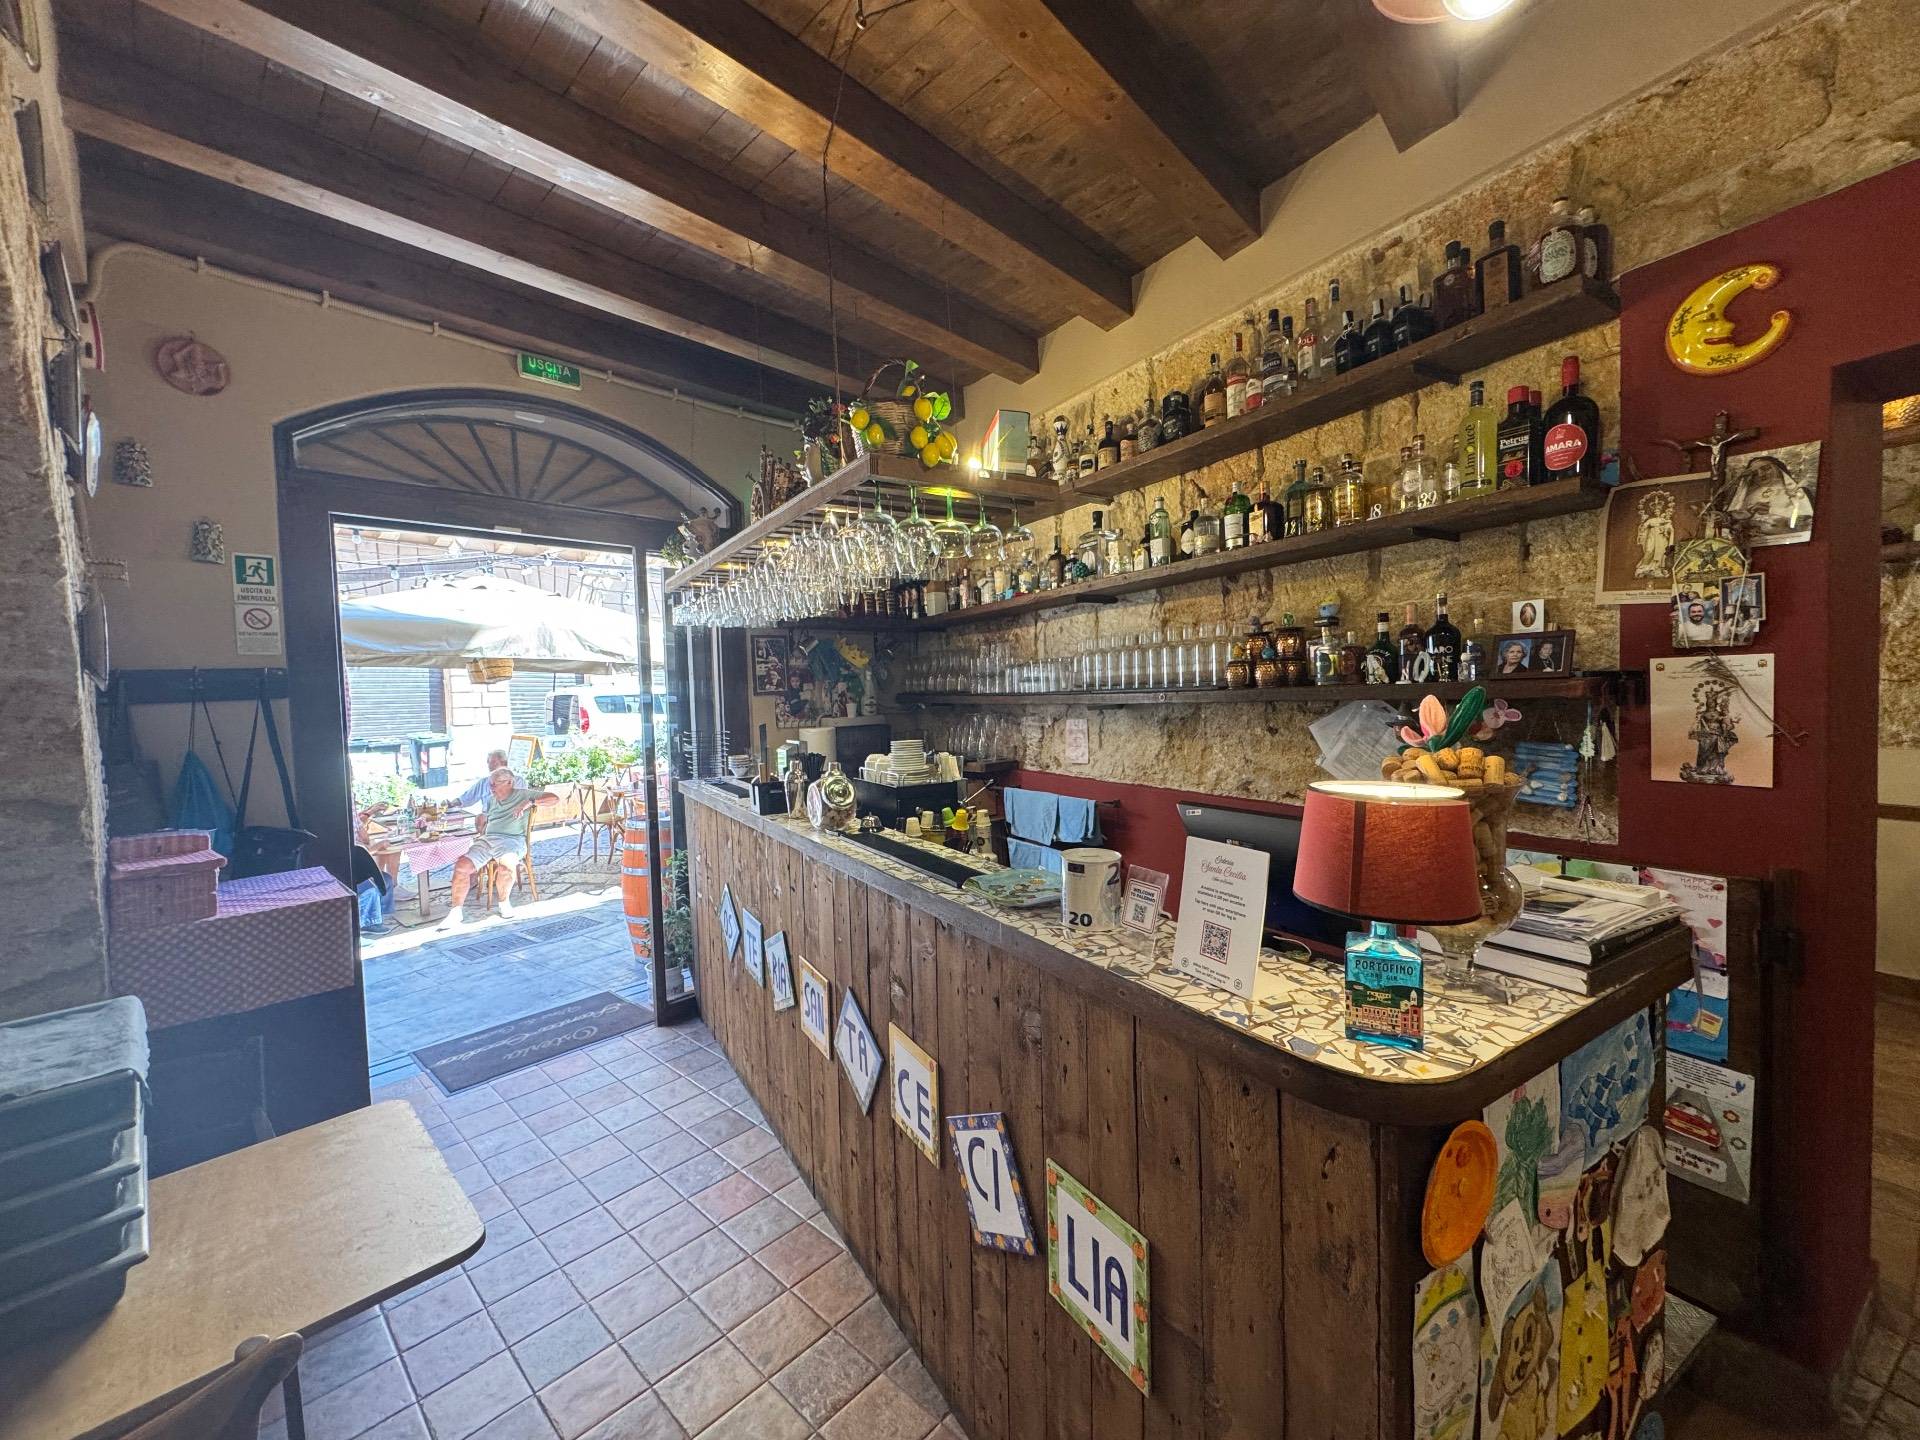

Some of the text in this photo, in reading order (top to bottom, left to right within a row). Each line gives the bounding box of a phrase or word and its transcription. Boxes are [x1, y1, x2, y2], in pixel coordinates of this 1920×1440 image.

[528, 356, 571, 377] USCITA
[542, 371, 560, 380] EXIT
[1500, 435, 1530, 449] Petrus
[1545, 439, 1582, 454] AMARA
[237, 594, 276, 602] EMERGENZA
[240, 587, 262, 595] USCITA
[1200, 861, 1223, 874] Santa
[1224, 866, 1247, 881] Cecilia
[1133, 887, 1155, 898] WELCOME
[1137, 892, 1156, 903] PALERMO
[1068, 911, 1093, 927] 20
[1355, 959, 1414, 976] PORTOFINO
[531, 1002, 621, 1038] Santa
[502, 1025, 599, 1061] Osteria
[723, 910, 1130, 1342] OS TE RIA SAN TA CE CI LIA
